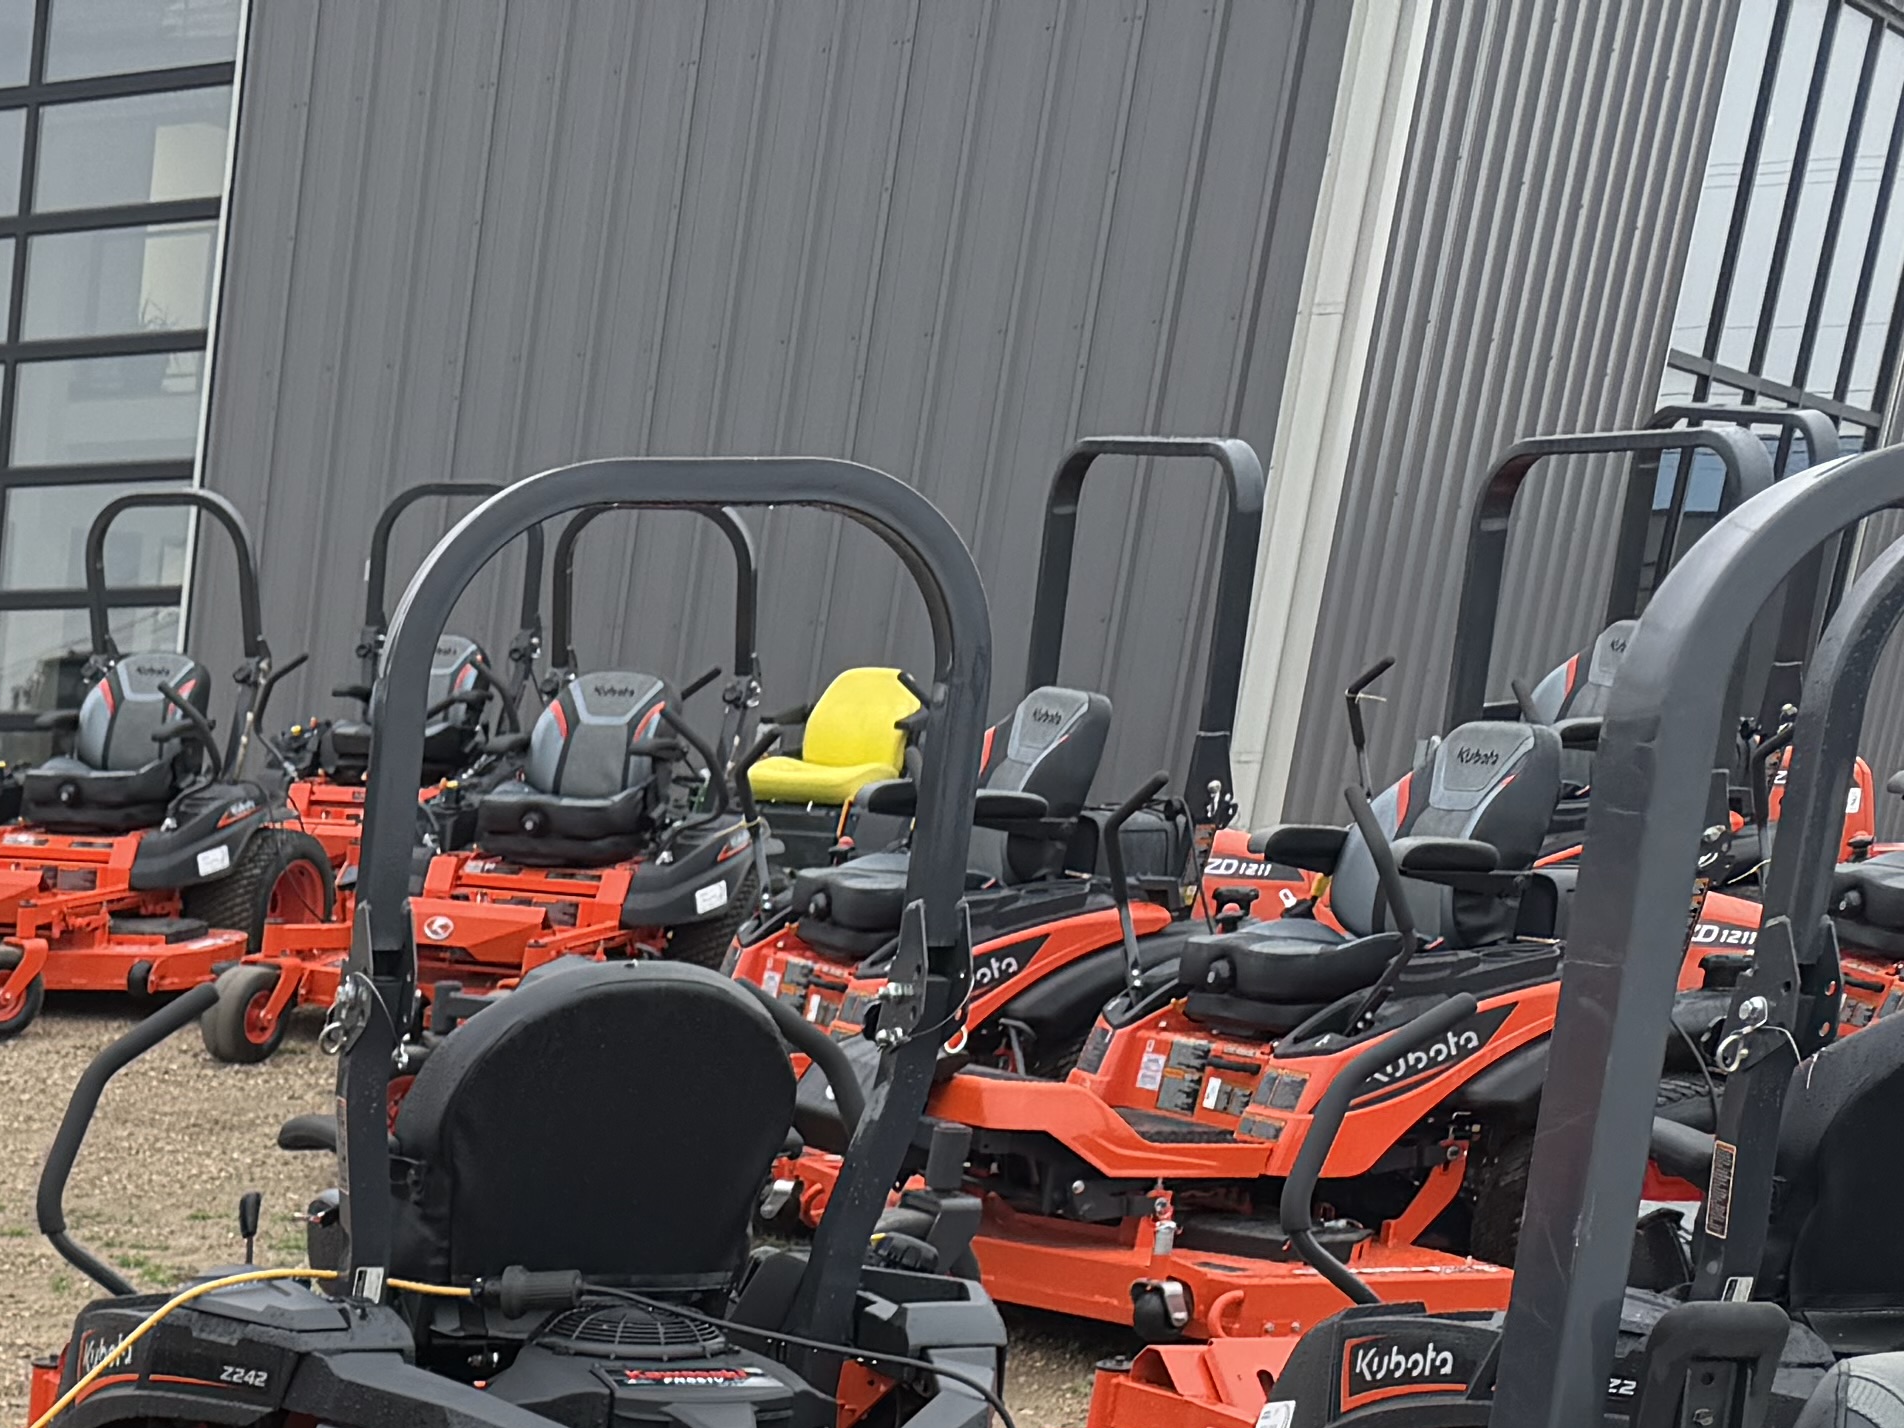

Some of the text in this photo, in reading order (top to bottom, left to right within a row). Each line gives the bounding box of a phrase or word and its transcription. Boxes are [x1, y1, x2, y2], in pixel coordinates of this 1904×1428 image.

[1457, 746, 1499, 765] Kubota
[1355, 1342, 1454, 1382] Kubota
[219, 1365, 268, 1388] Z242
